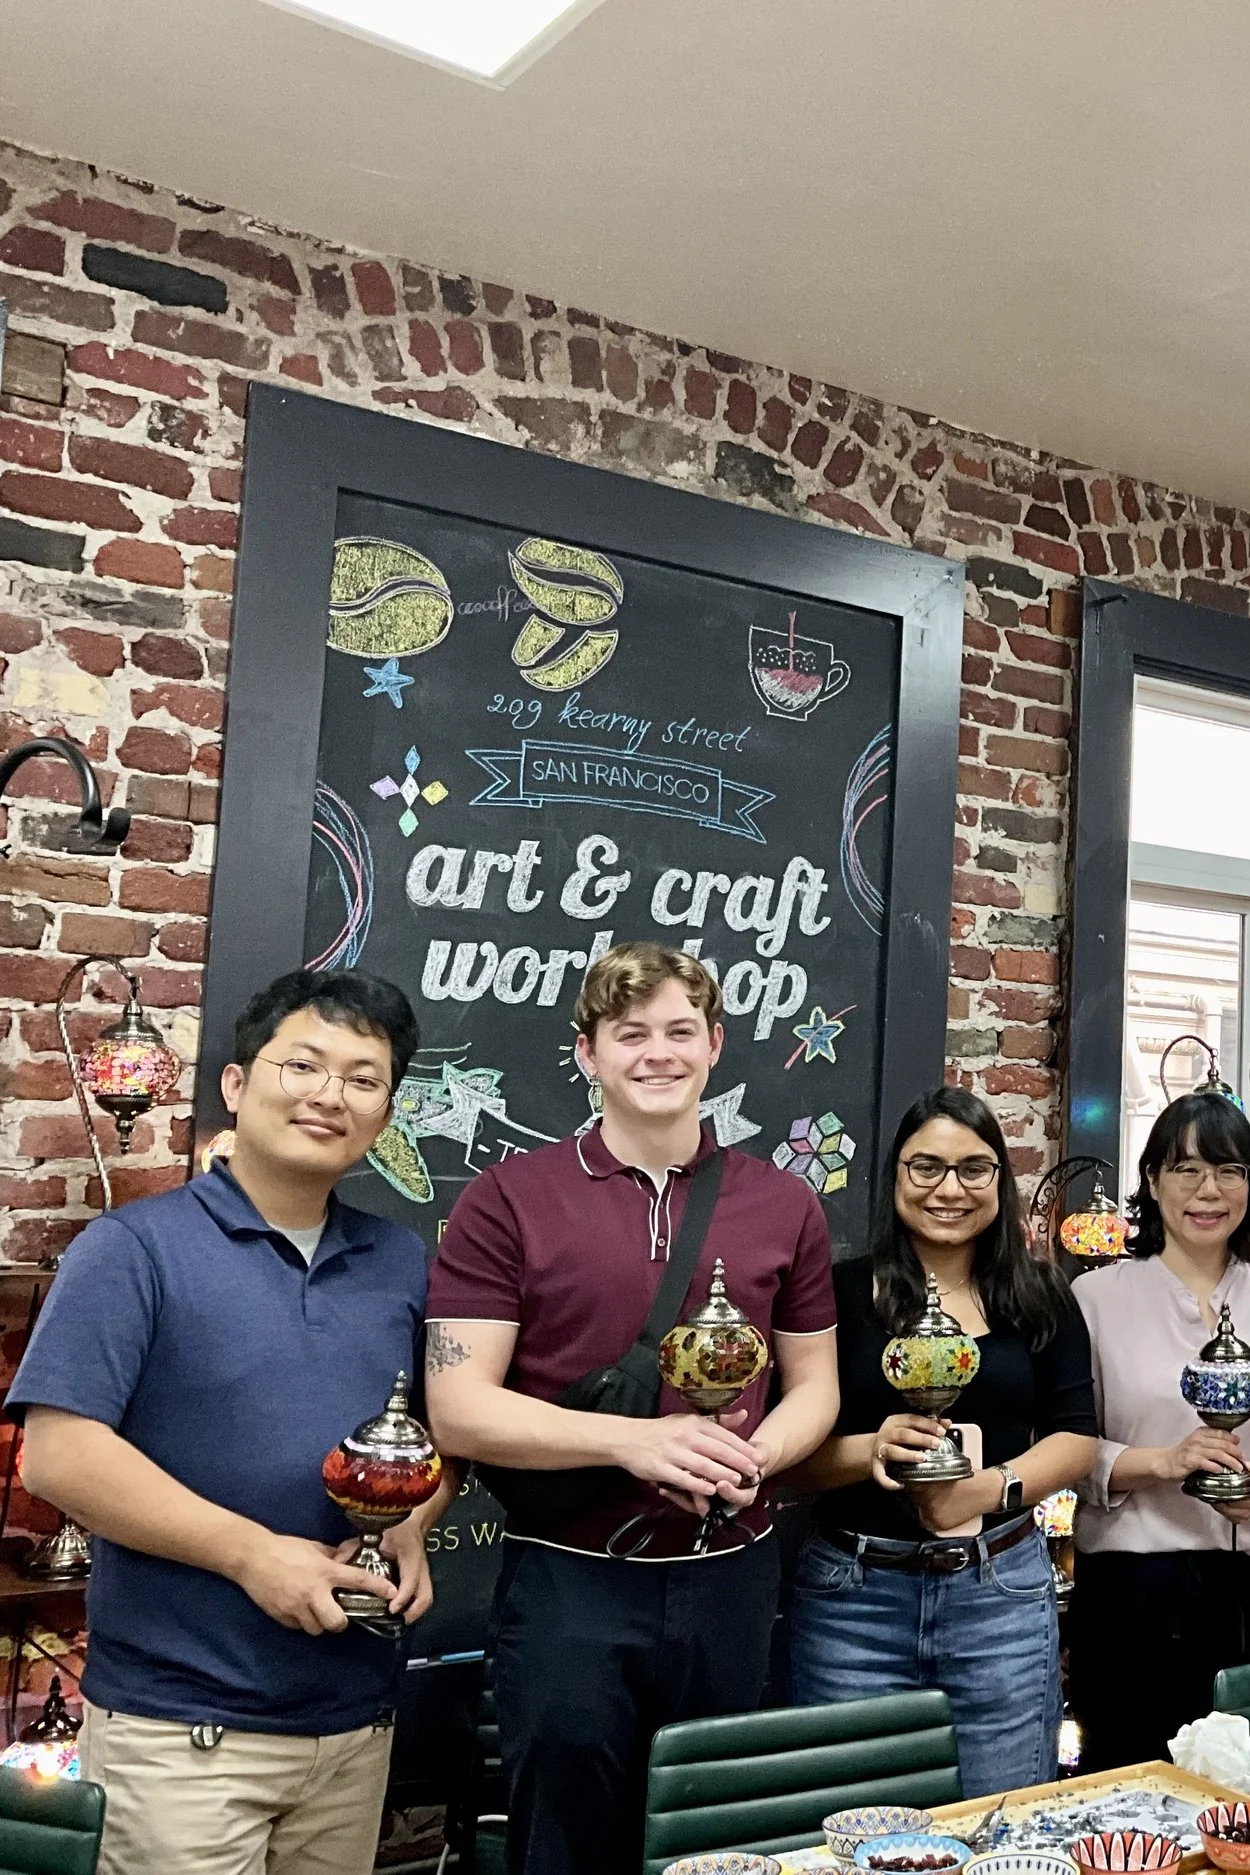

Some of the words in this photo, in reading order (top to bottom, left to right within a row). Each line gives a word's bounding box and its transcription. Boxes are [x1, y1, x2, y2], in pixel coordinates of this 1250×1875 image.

[487, 694, 542, 729] 209
[558, 692, 652, 753] kearny
[662, 717, 751, 752] street
[532, 758, 578, 784] SAN
[583, 761, 710, 804] FRANCISCO
[406, 840, 544, 913] art
[560, 834, 631, 920] &
[650, 855, 832, 958] craft
[421, 930, 808, 1041] worop
